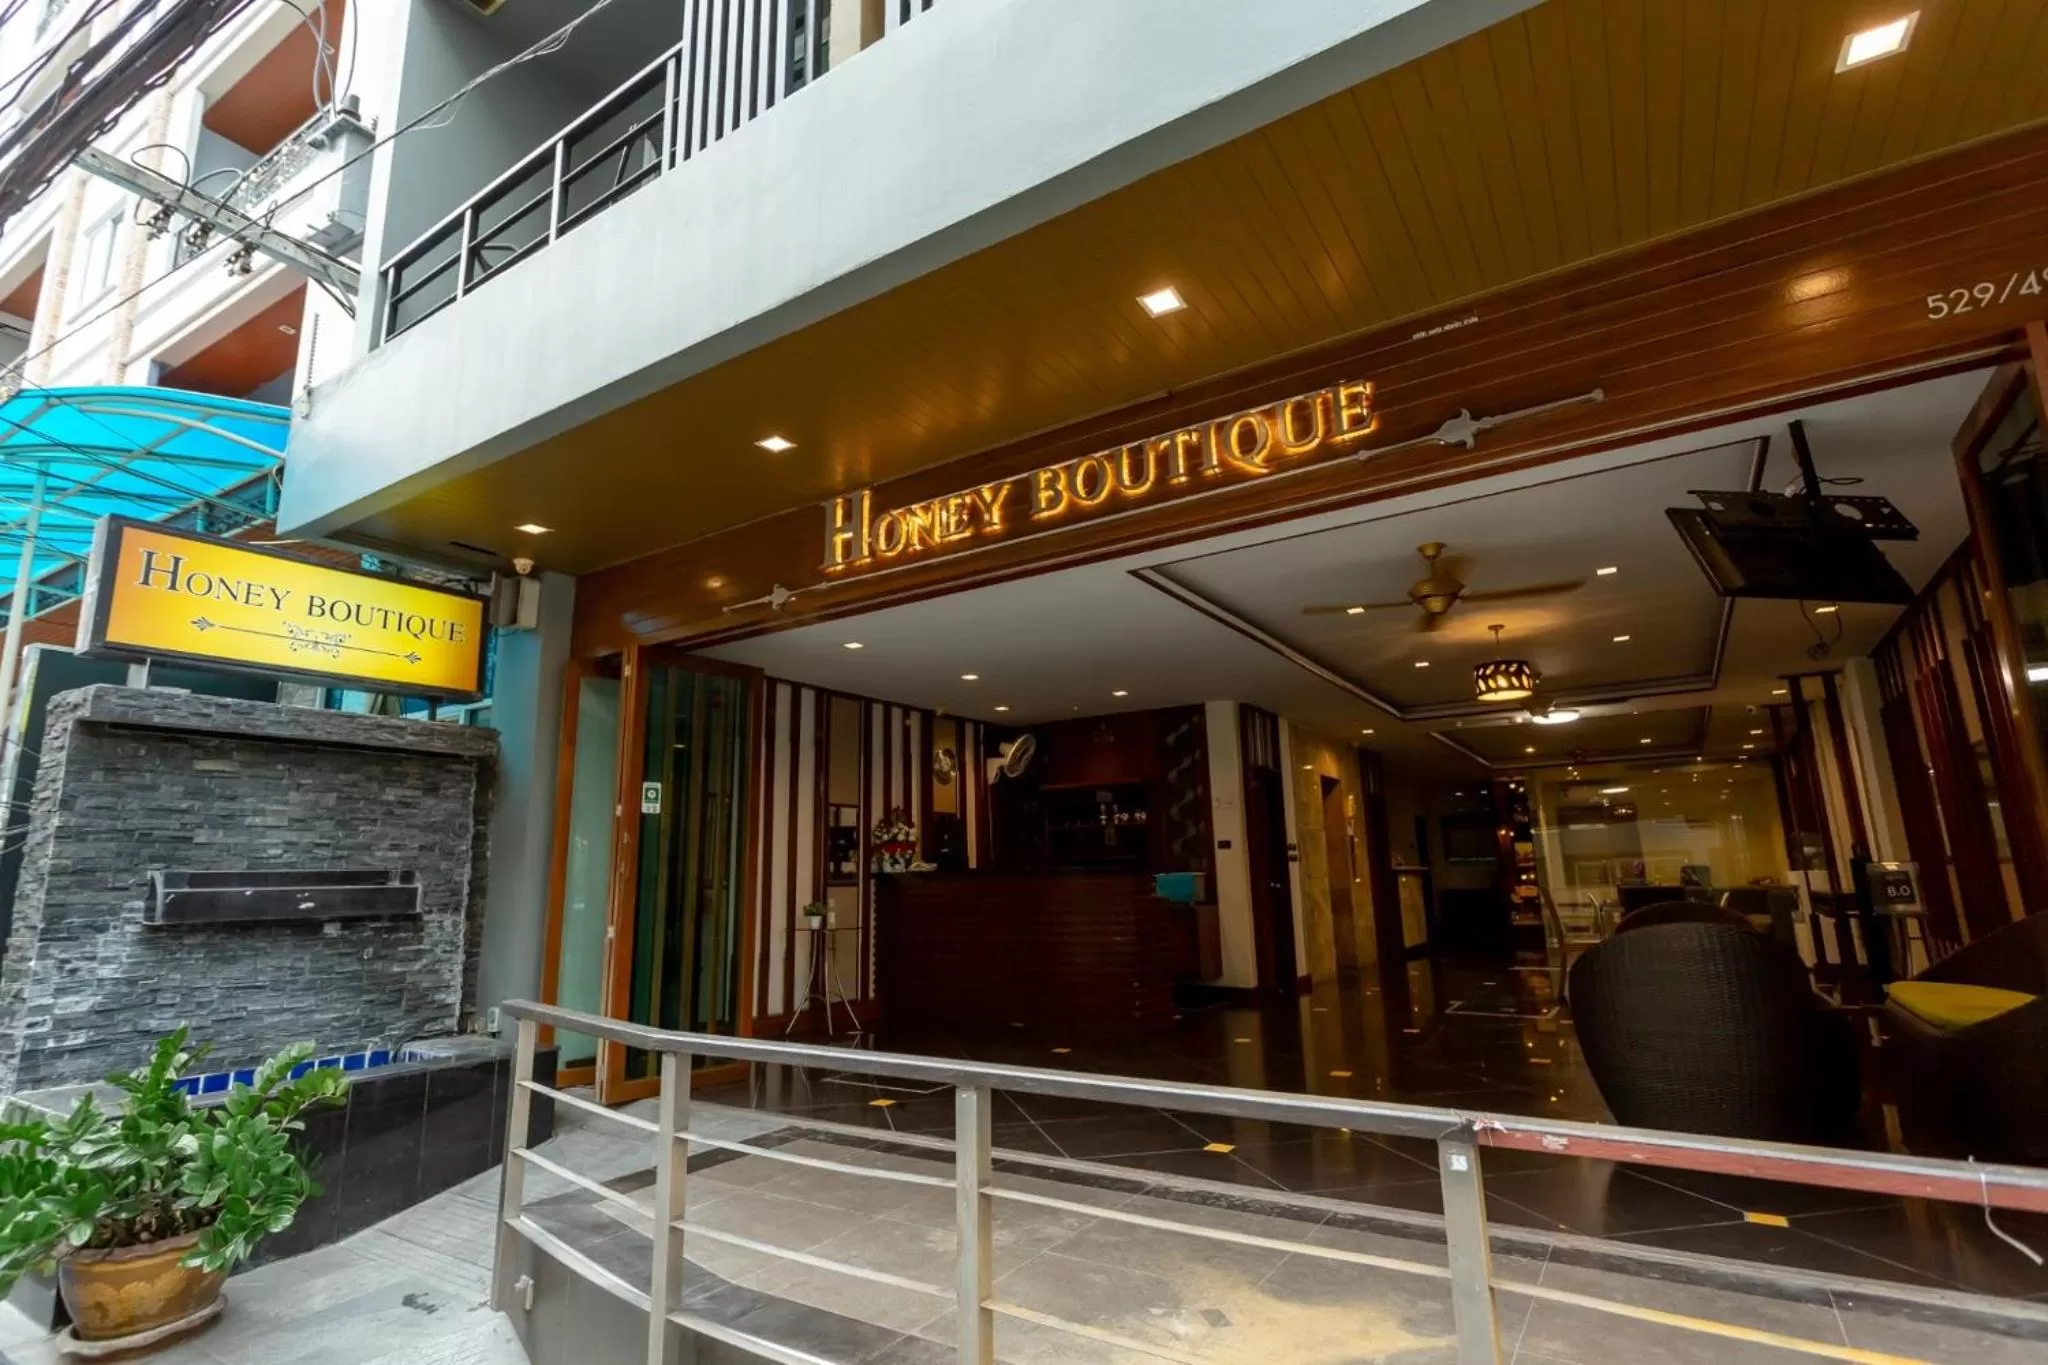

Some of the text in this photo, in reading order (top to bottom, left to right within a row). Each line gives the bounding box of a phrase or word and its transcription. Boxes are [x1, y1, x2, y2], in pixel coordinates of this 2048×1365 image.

[819, 379, 1378, 573] HONEY BOUTIQUE
[137, 548, 465, 643] HONEY BOUTIQUE
